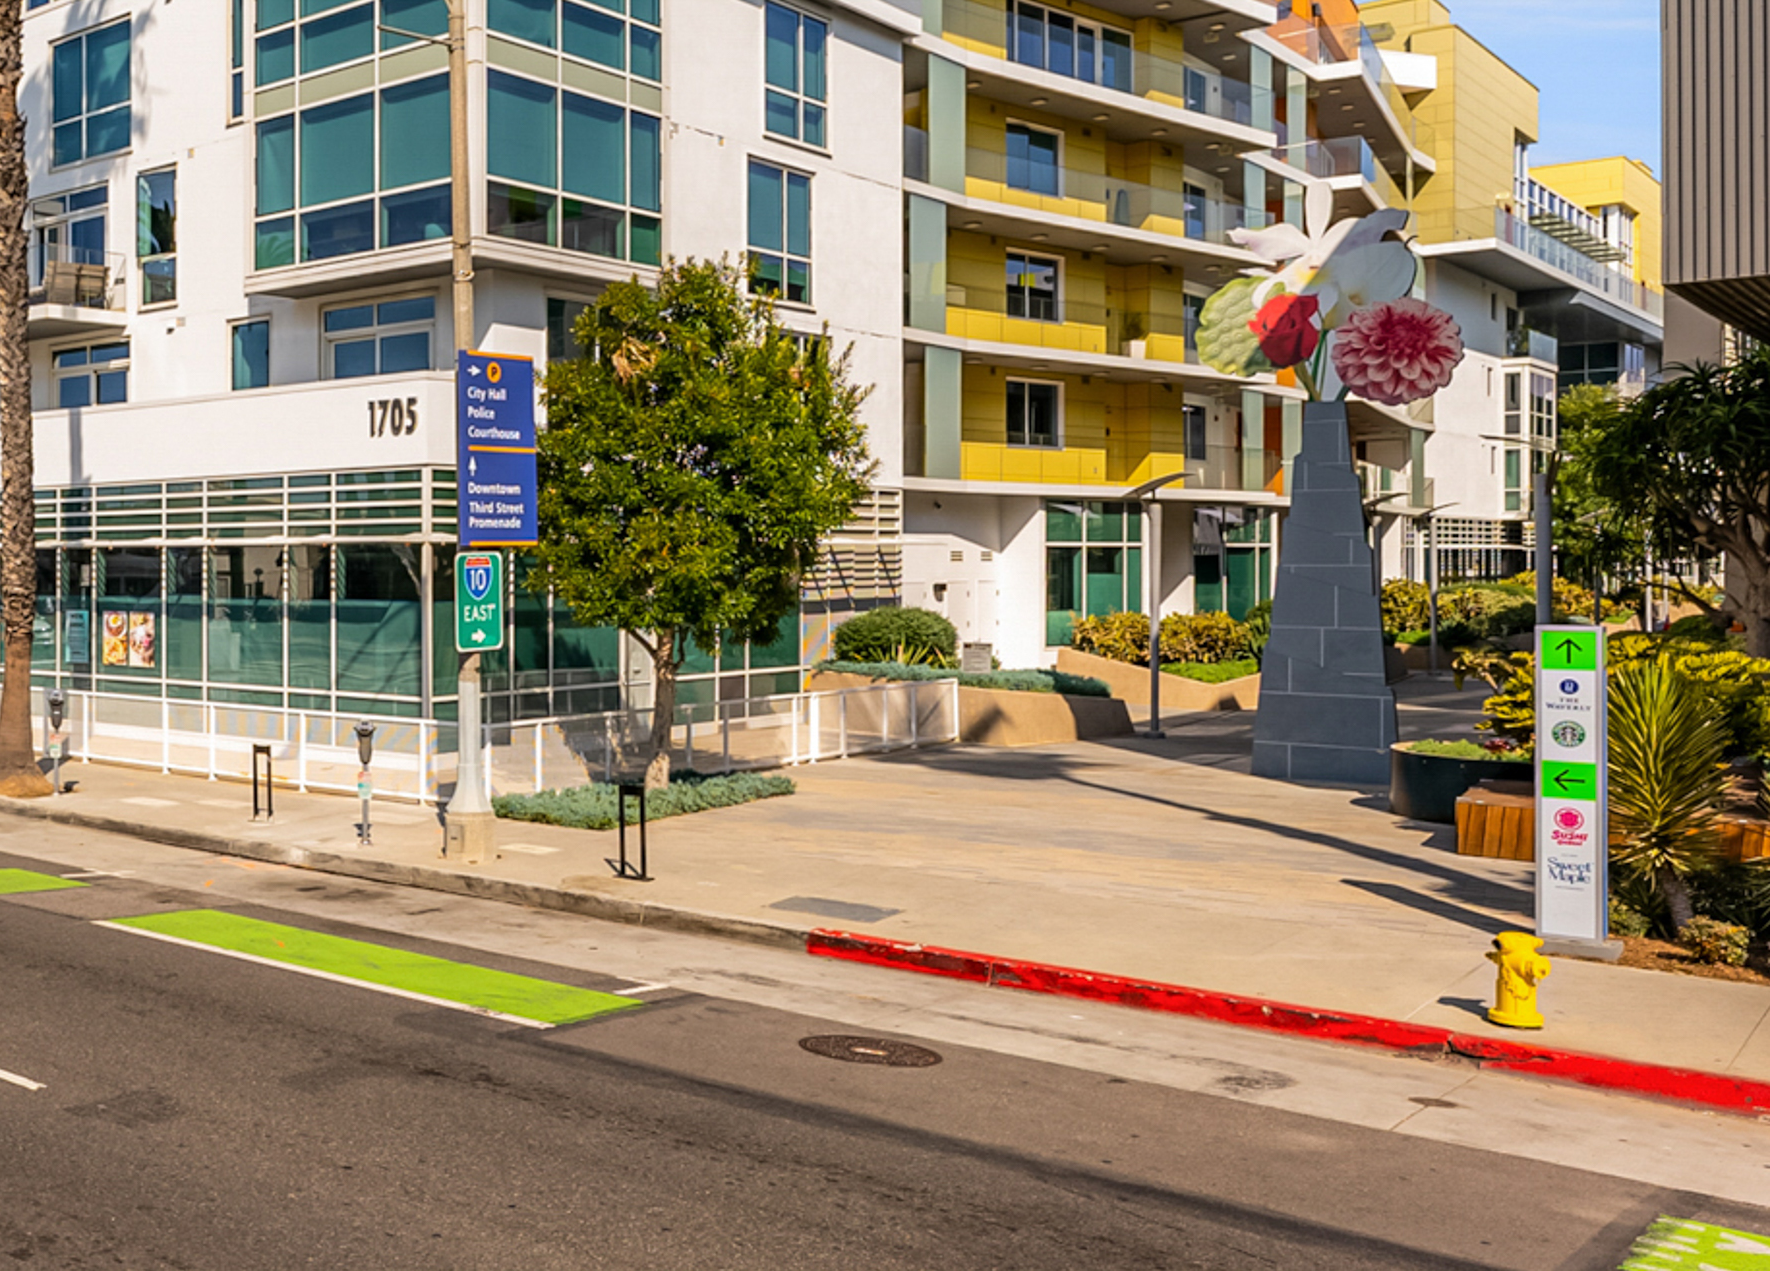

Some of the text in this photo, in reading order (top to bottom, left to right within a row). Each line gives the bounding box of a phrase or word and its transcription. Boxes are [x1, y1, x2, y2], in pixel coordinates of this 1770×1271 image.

[467, 386, 507, 402] City Hall
[368, 396, 418, 438] 1705
[467, 405, 495, 420] Police
[467, 425, 521, 441] Courthouse
[468, 481, 521, 496] Downtown
[469, 500, 524, 515] Third Street
[469, 515, 522, 529] Promenade
[470, 568, 487, 591] 10
[464, 603, 496, 622] EAST
